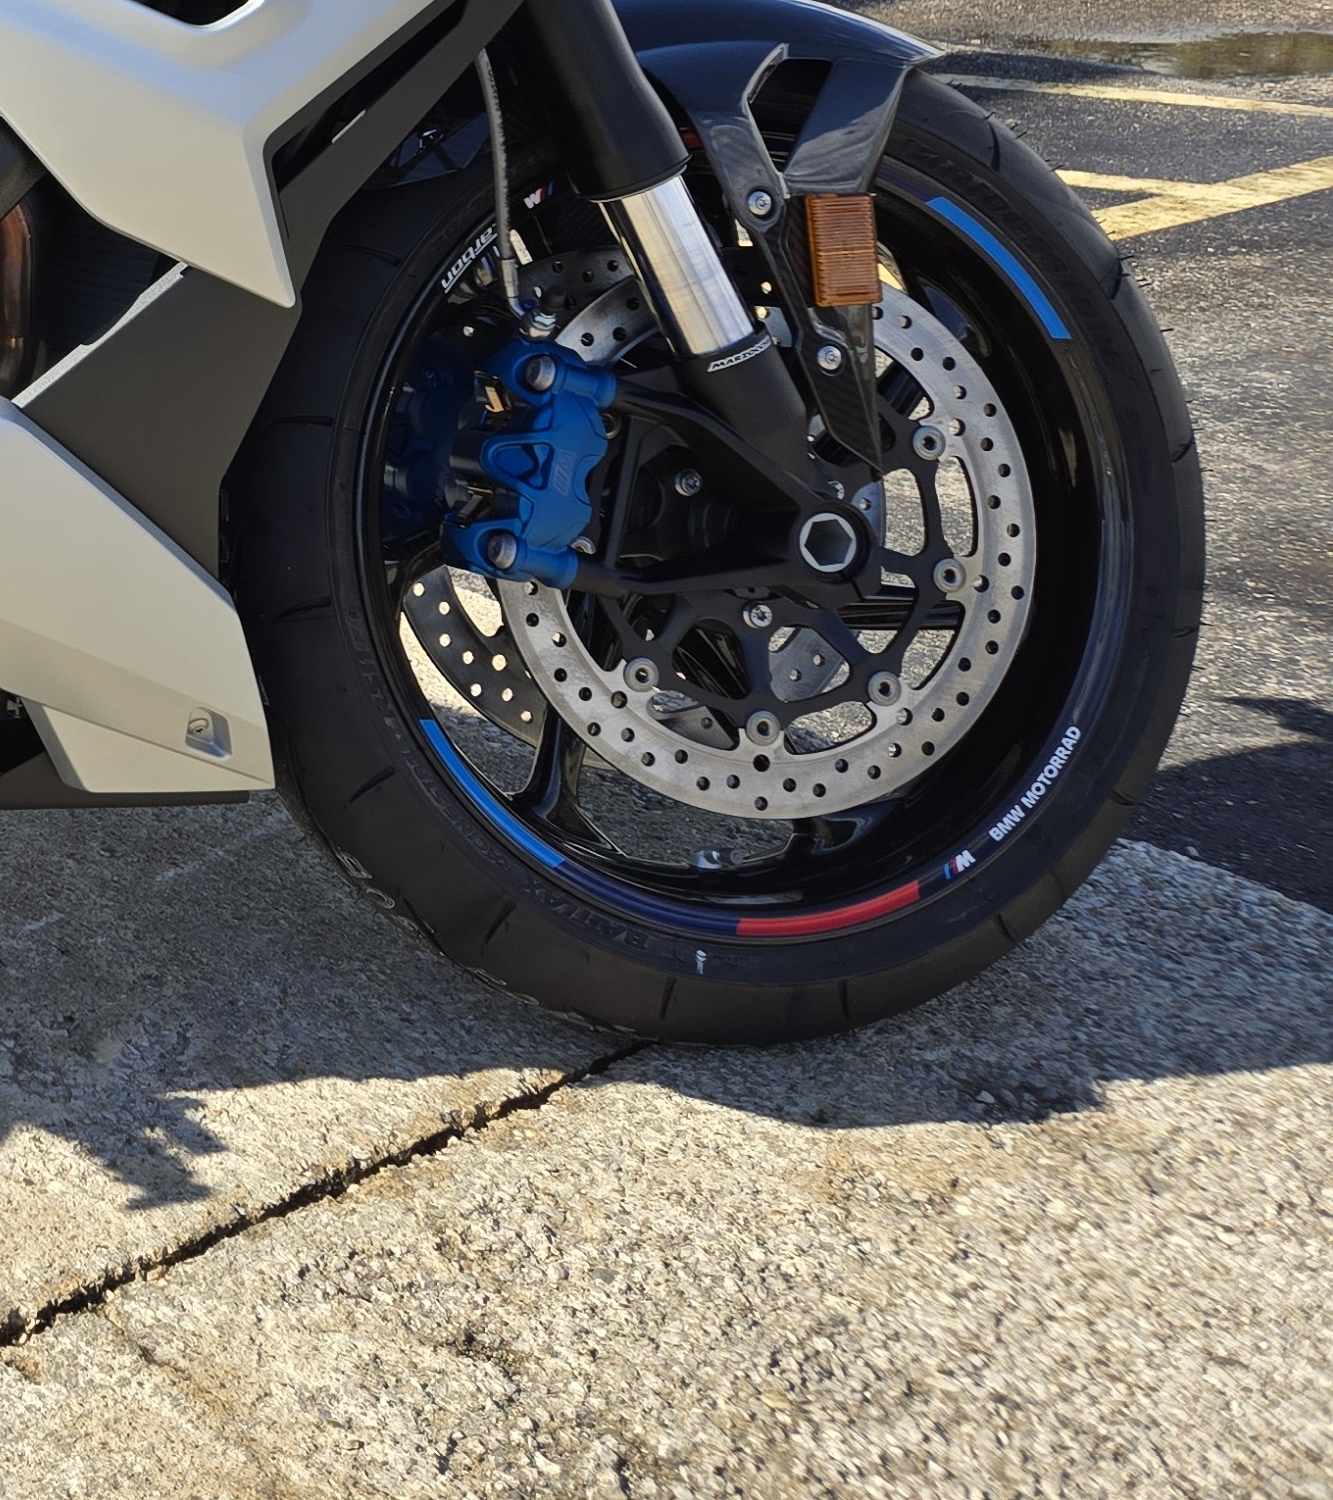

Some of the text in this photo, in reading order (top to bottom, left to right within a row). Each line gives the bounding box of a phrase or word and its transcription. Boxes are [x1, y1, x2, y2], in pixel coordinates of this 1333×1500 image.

[440, 222, 502, 294] arbon
[988, 725, 1082, 842] BMW MOTORRAD
